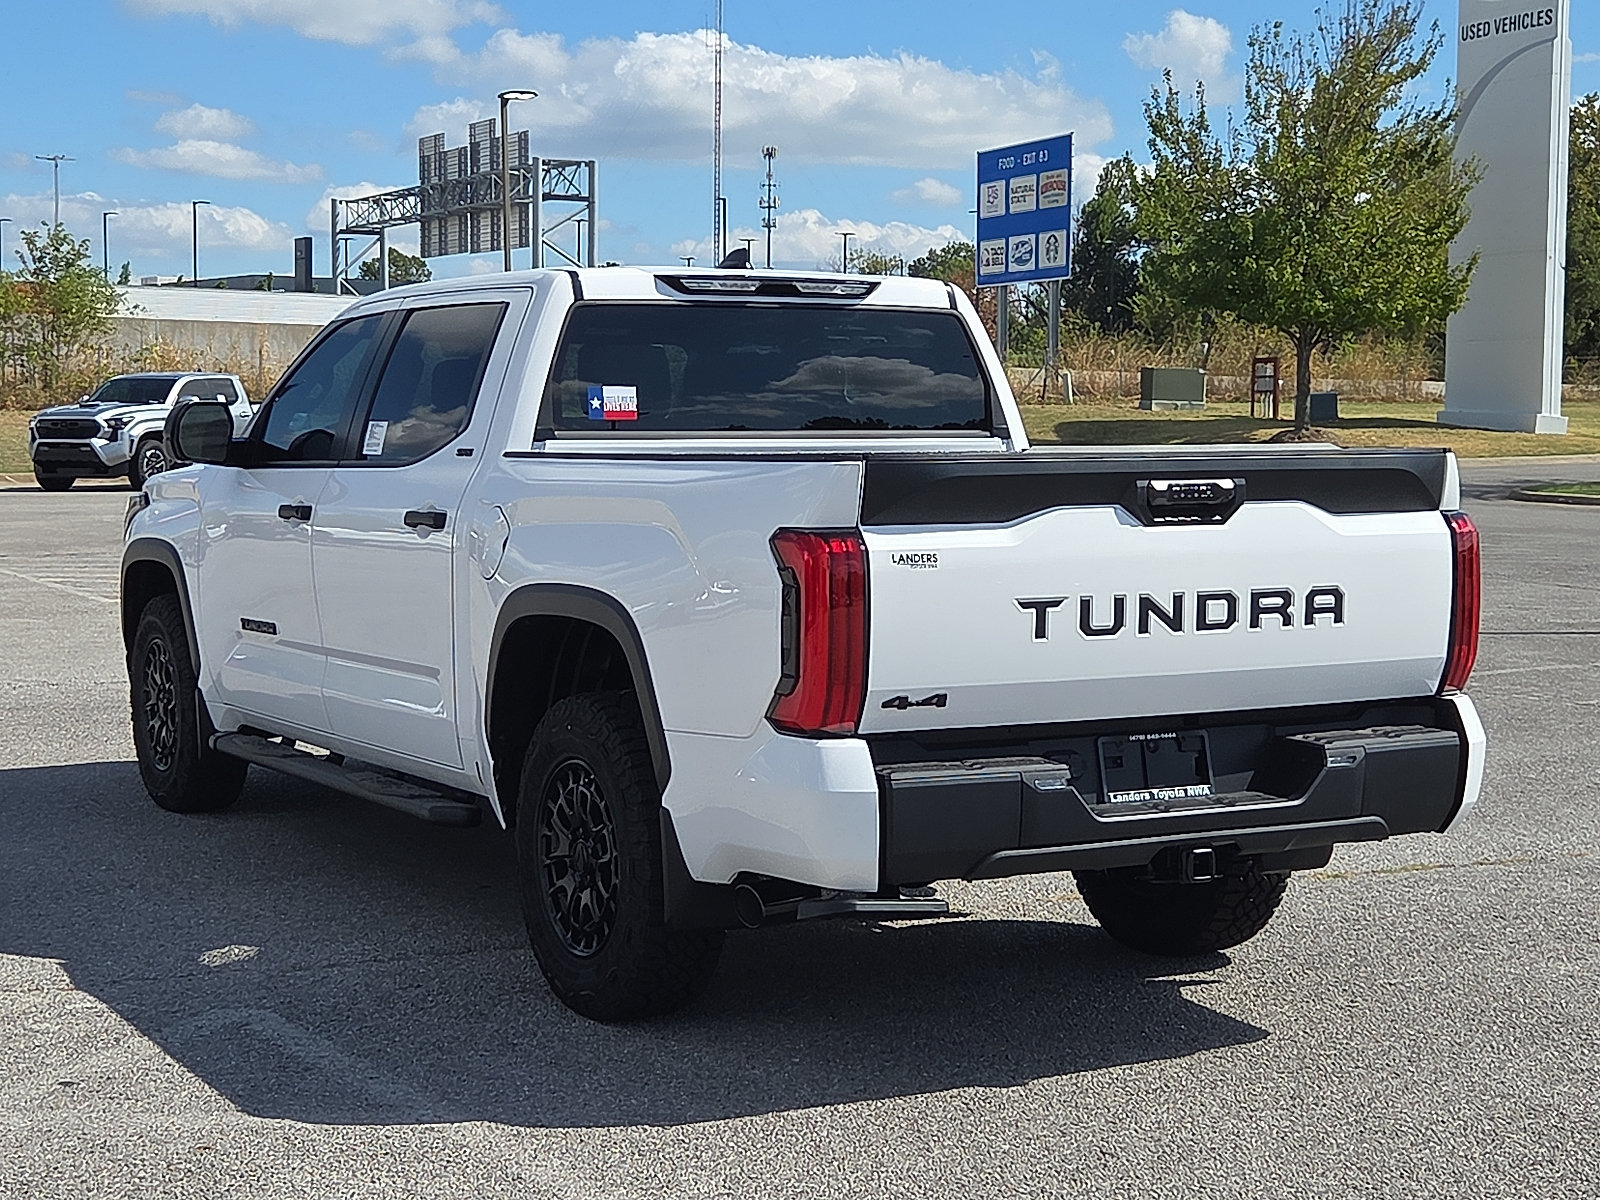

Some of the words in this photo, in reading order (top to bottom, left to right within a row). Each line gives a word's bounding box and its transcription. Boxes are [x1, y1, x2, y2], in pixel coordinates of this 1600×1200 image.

[1461, 21, 1490, 41] USED
[1494, 9, 1553, 34] VEHICLES
[998, 157, 1014, 169] FOOD
[1011, 184, 1035, 195] NATURAL
[1011, 194, 1025, 204] STATE
[991, 247, 1004, 256] TACO
[991, 257, 1004, 266] BELL
[891, 553, 938, 565] LANDERS
[1014, 584, 1346, 642] TUNDRA
[242, 618, 274, 635] TUNDRA
[1108, 793, 1150, 803] Landers
[1152, 788, 1185, 800] Toyota
[1187, 786, 1211, 797] NWA
